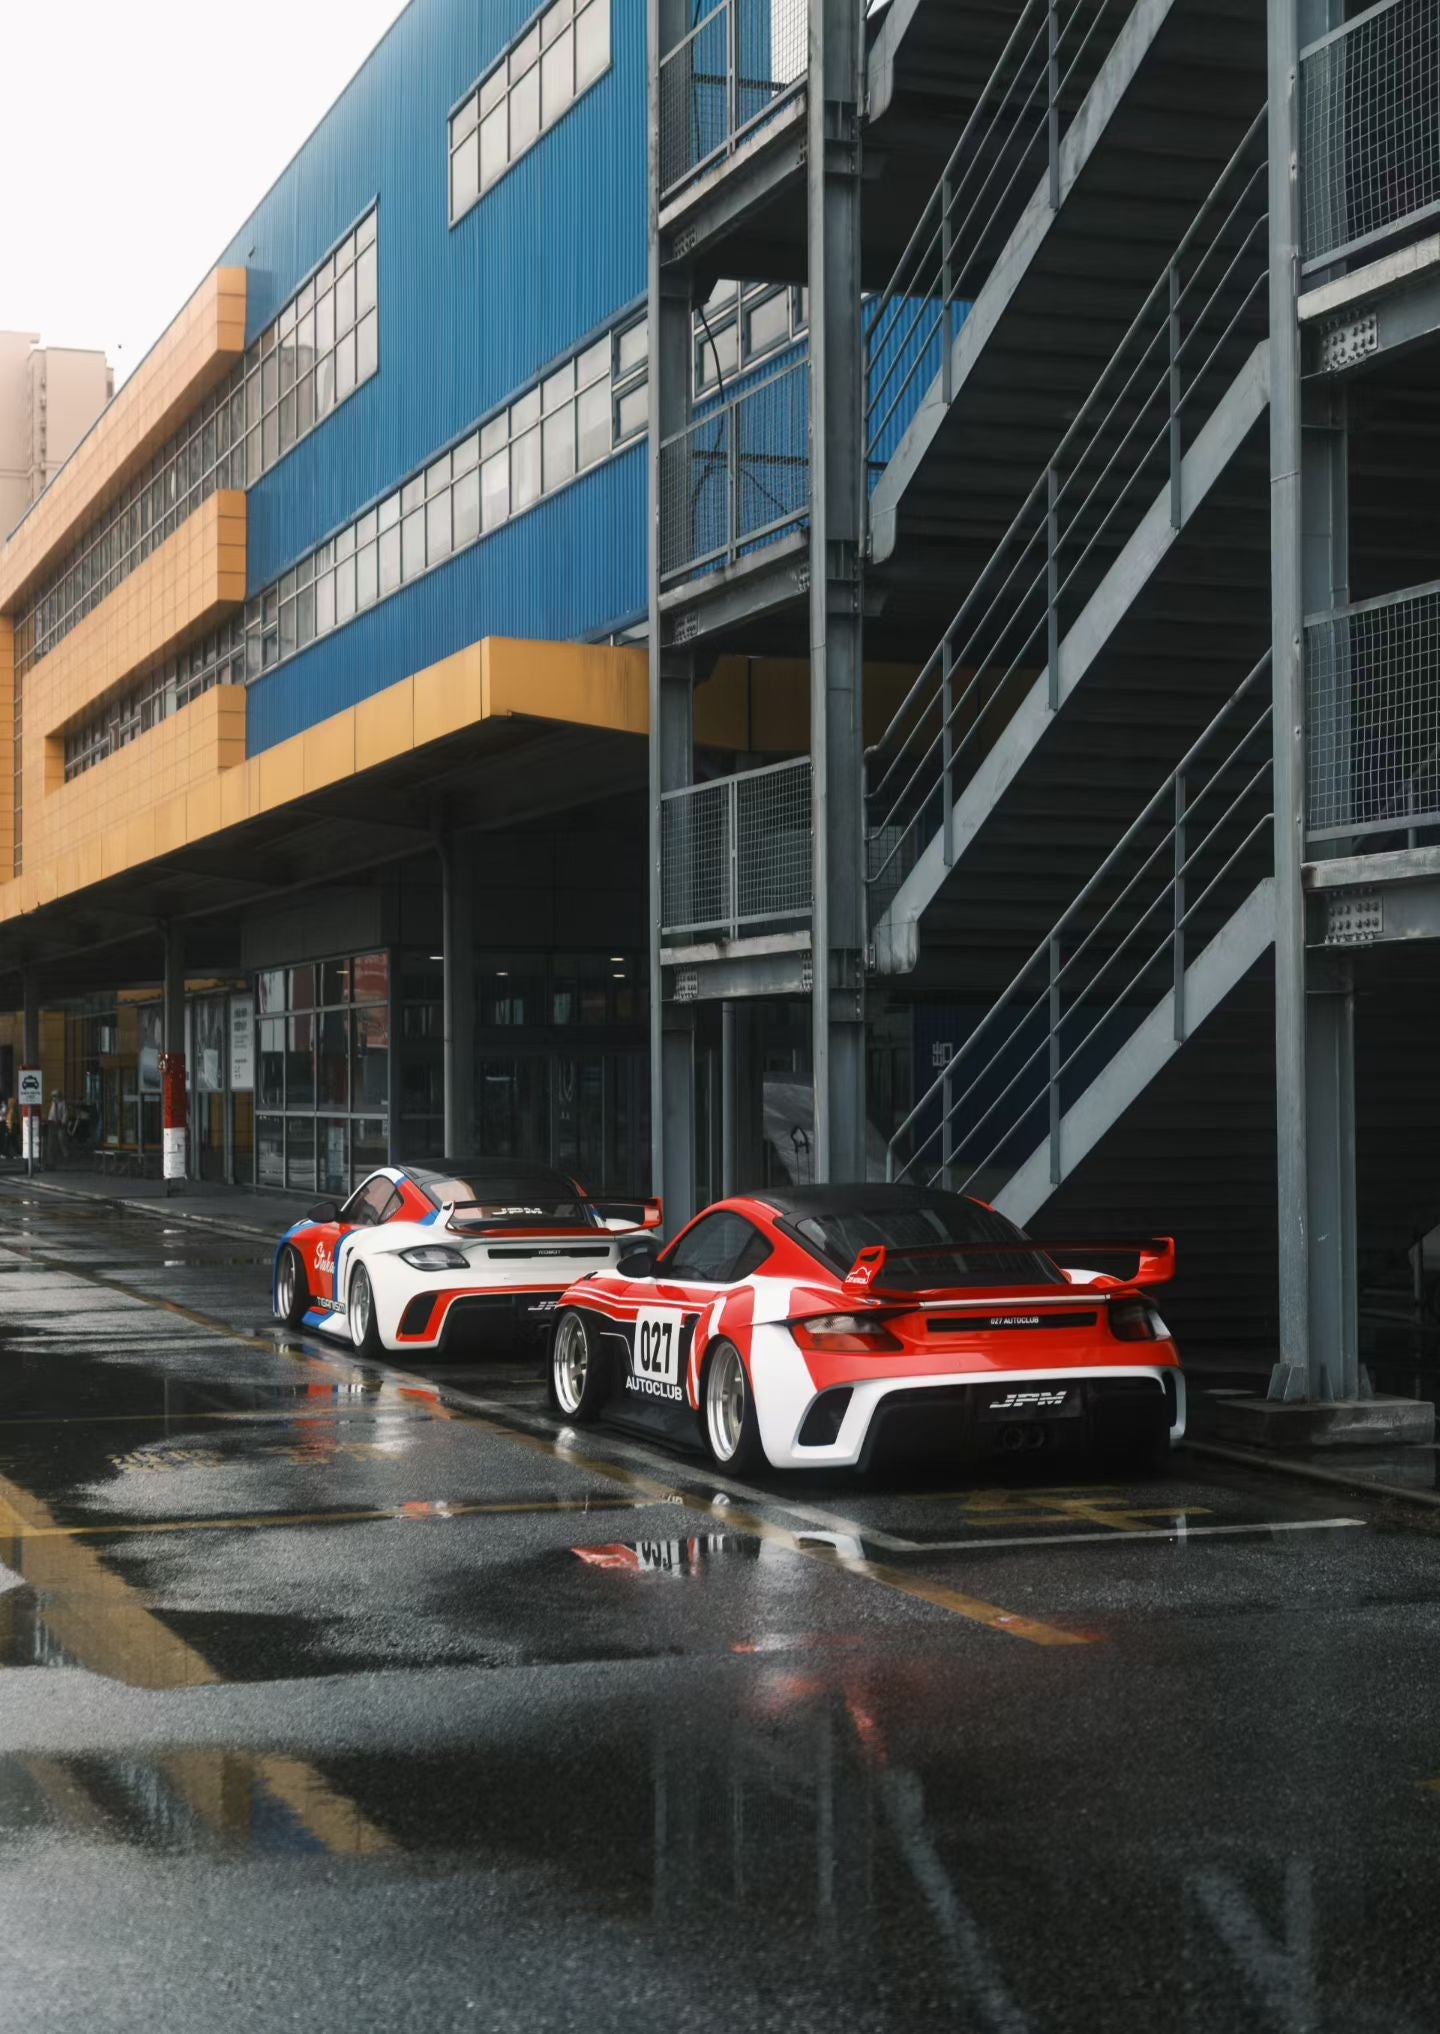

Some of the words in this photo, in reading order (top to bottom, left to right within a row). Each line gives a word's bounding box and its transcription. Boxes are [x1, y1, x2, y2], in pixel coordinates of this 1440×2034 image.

[492, 1208, 543, 1216] JPM
[528, 1301, 558, 1311] JP
[991, 1317, 1003, 1325] 027
[1004, 1316, 1039, 1325] AUTOCLUB
[641, 1320, 672, 1374] 027
[626, 1376, 682, 1401] AUTOCLUB
[990, 1391, 1067, 1409] JPM
